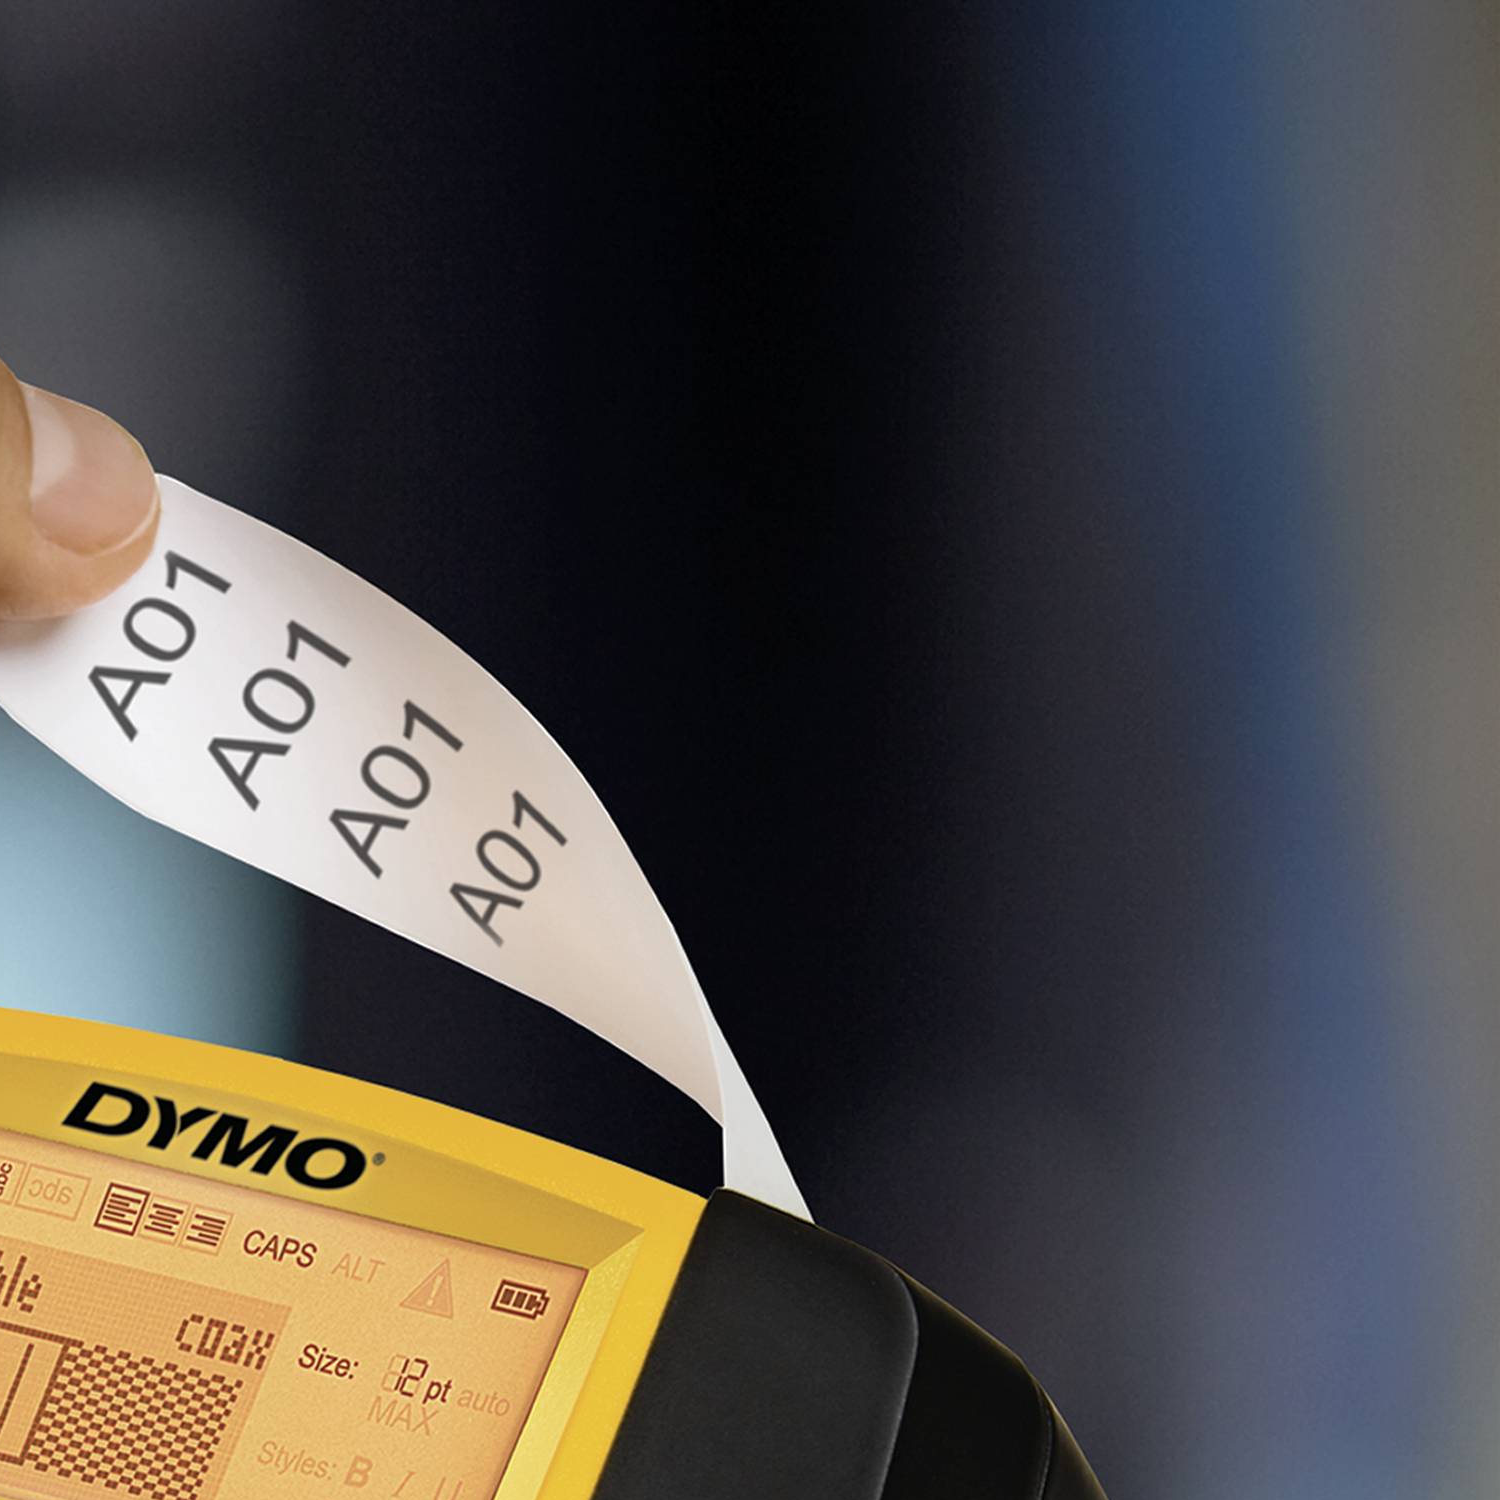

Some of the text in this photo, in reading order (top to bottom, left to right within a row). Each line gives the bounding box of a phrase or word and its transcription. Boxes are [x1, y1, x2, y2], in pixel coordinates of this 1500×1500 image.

[88, 549, 233, 742] A01
[208, 619, 352, 812] A01
[328, 699, 465, 880] A01
[448, 789, 568, 948] A01
[243, 1229, 318, 1268] CAPS
[332, 1252, 386, 1284] ALT
[298, 1343, 359, 1380] Size:
[456, 1389, 510, 1417] auto
[367, 1395, 439, 1436] MAX
[257, 1440, 337, 1481] Styles:
[343, 1455, 373, 1488] B
